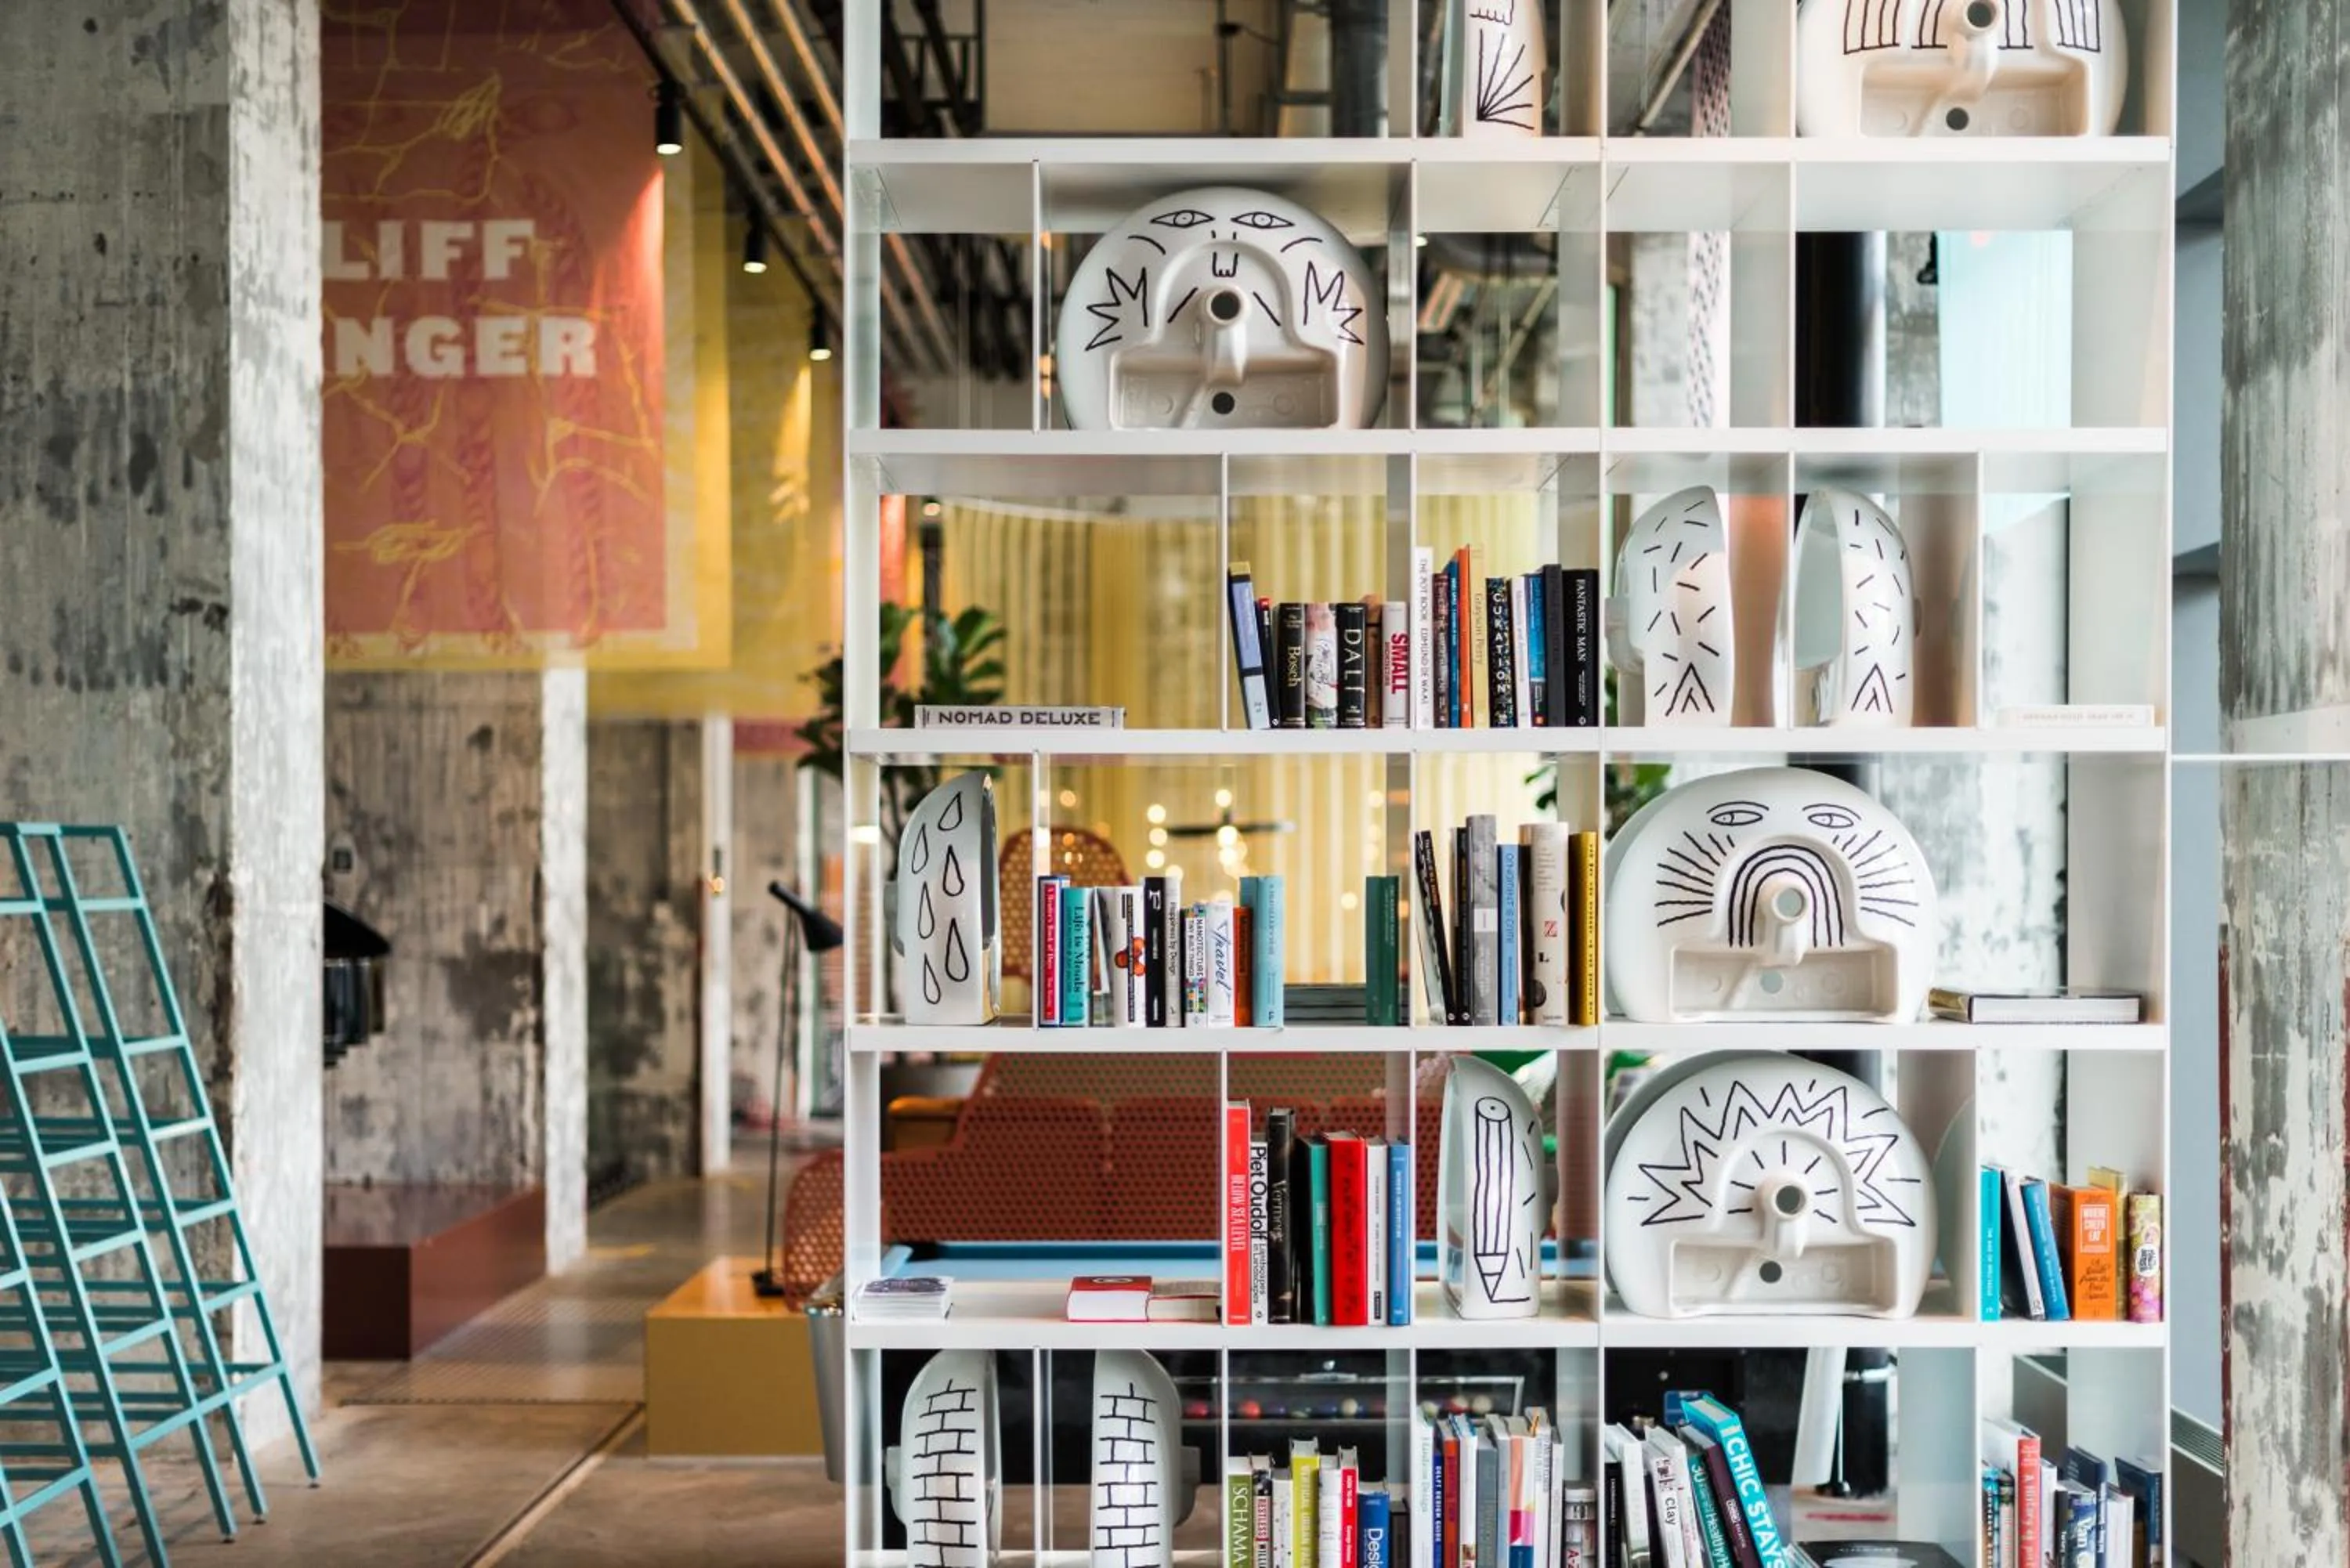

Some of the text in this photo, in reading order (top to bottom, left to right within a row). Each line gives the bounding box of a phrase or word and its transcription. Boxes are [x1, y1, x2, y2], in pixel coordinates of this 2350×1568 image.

[322, 219, 535, 281] LIFF
[334, 316, 598, 378] NGER
[1576, 579, 1586, 633] FANTASTIC
[1473, 593, 1485, 666] Grayson Perry
[1577, 636, 1586, 662] MAN
[1287, 645, 1303, 688] Bosch
[1391, 633, 1409, 695] SMALL
[938, 712, 1101, 725] NOMAD DELUXE
[1073, 906, 1085, 931] Life
[1168, 901, 1177, 938] Happiness
[1168, 941, 1177, 949] by
[1210, 920, 1232, 995] Travel
[1074, 952, 1085, 993] Meals
[1231, 1174, 1246, 1204] BELOW
[1250, 1146, 1267, 1240] Piet Oudolf
[1230, 1207, 1246, 1224] SEA
[1230, 1226, 1246, 1251] LEVEL
[1726, 1436, 1760, 1498] CHIC
[1232, 1487, 1249, 1563] SCHAMA
